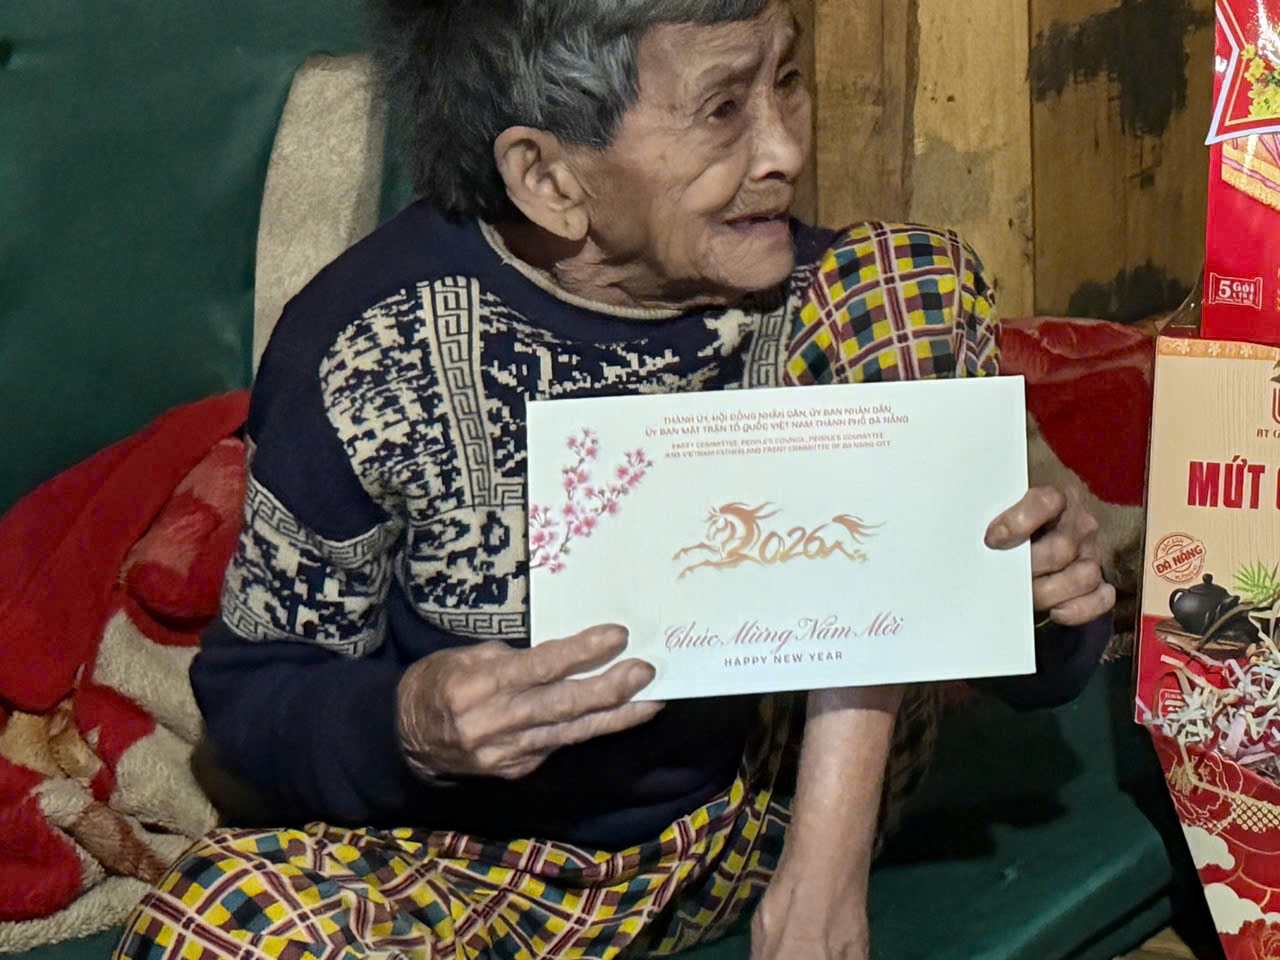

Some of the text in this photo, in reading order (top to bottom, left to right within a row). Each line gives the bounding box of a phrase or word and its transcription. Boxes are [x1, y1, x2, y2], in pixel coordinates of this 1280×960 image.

[1218, 280, 1231, 298] 5
[1187, 455, 1266, 510] MỨT
[664, 620, 720, 651] Chúc
[722, 619, 795, 654] Mừng
[796, 615, 850, 641] Năm
[724, 651, 843, 667] HAPPY NEW YEAR
